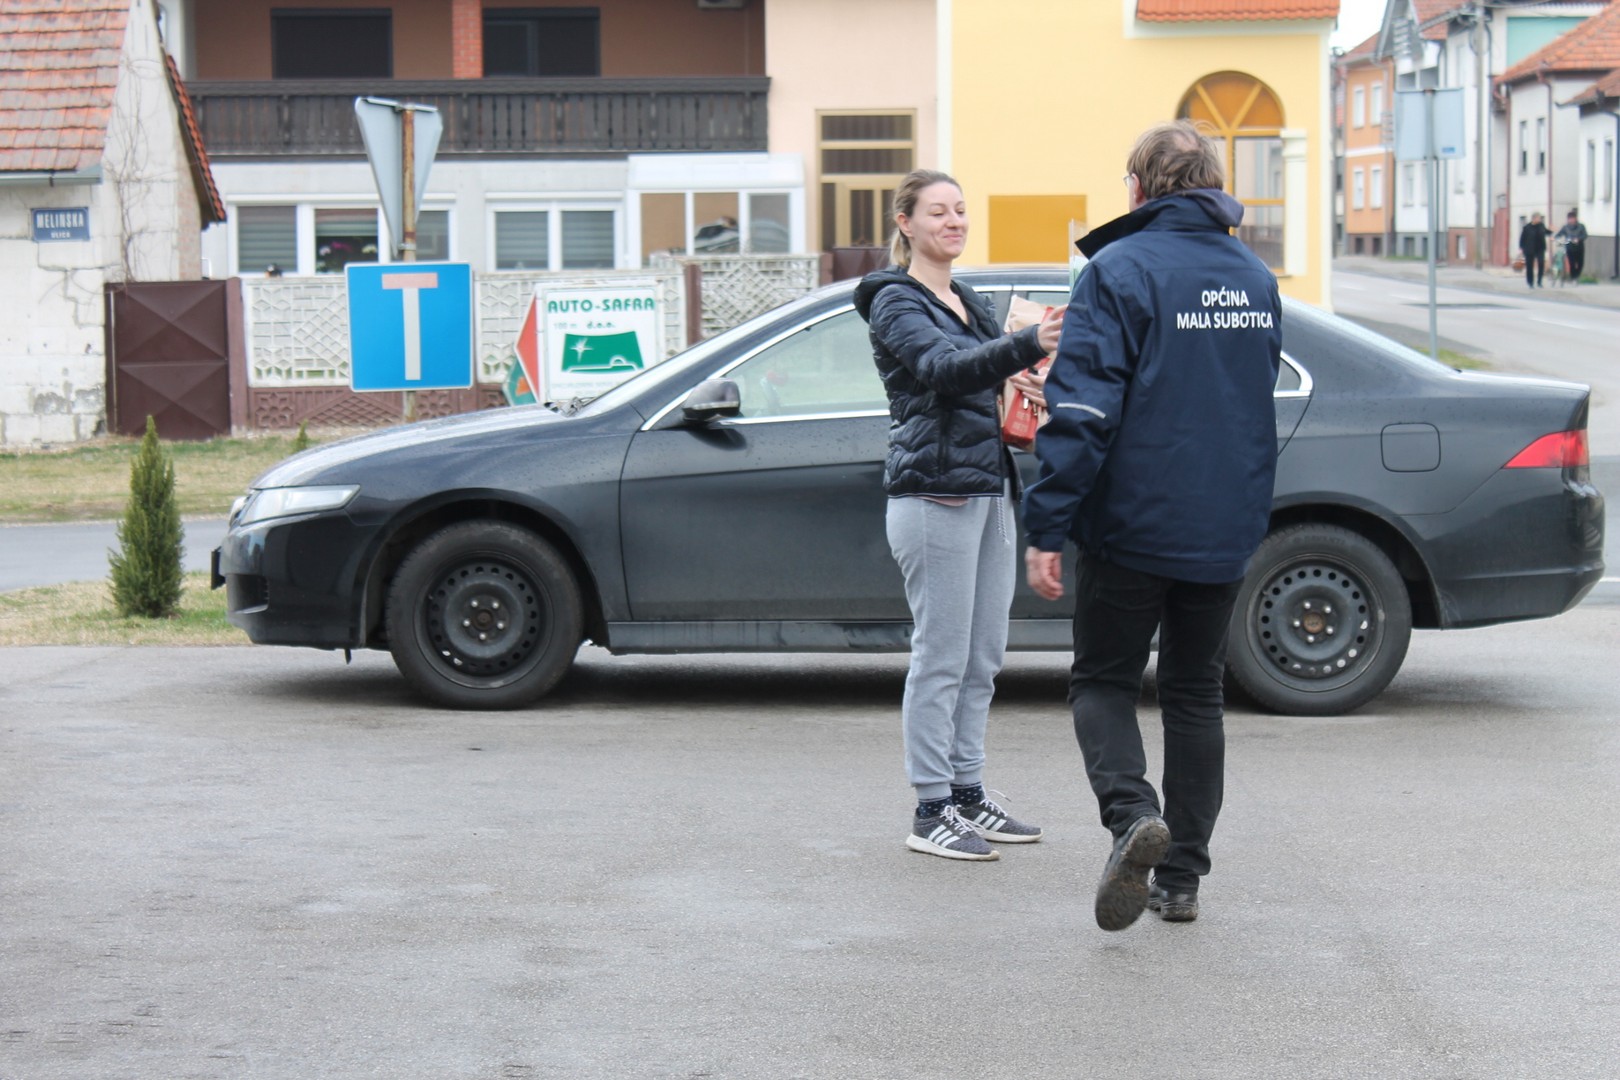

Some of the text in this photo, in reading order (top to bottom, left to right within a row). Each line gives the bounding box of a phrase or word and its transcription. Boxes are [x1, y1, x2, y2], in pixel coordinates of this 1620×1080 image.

[36, 212, 84, 229] MELINSKA
[547, 297, 655, 314] AUTO-SAFRA
[1201, 286, 1250, 307] OPĆINA
[1176, 311, 1274, 330] MALA SUBOTICA
